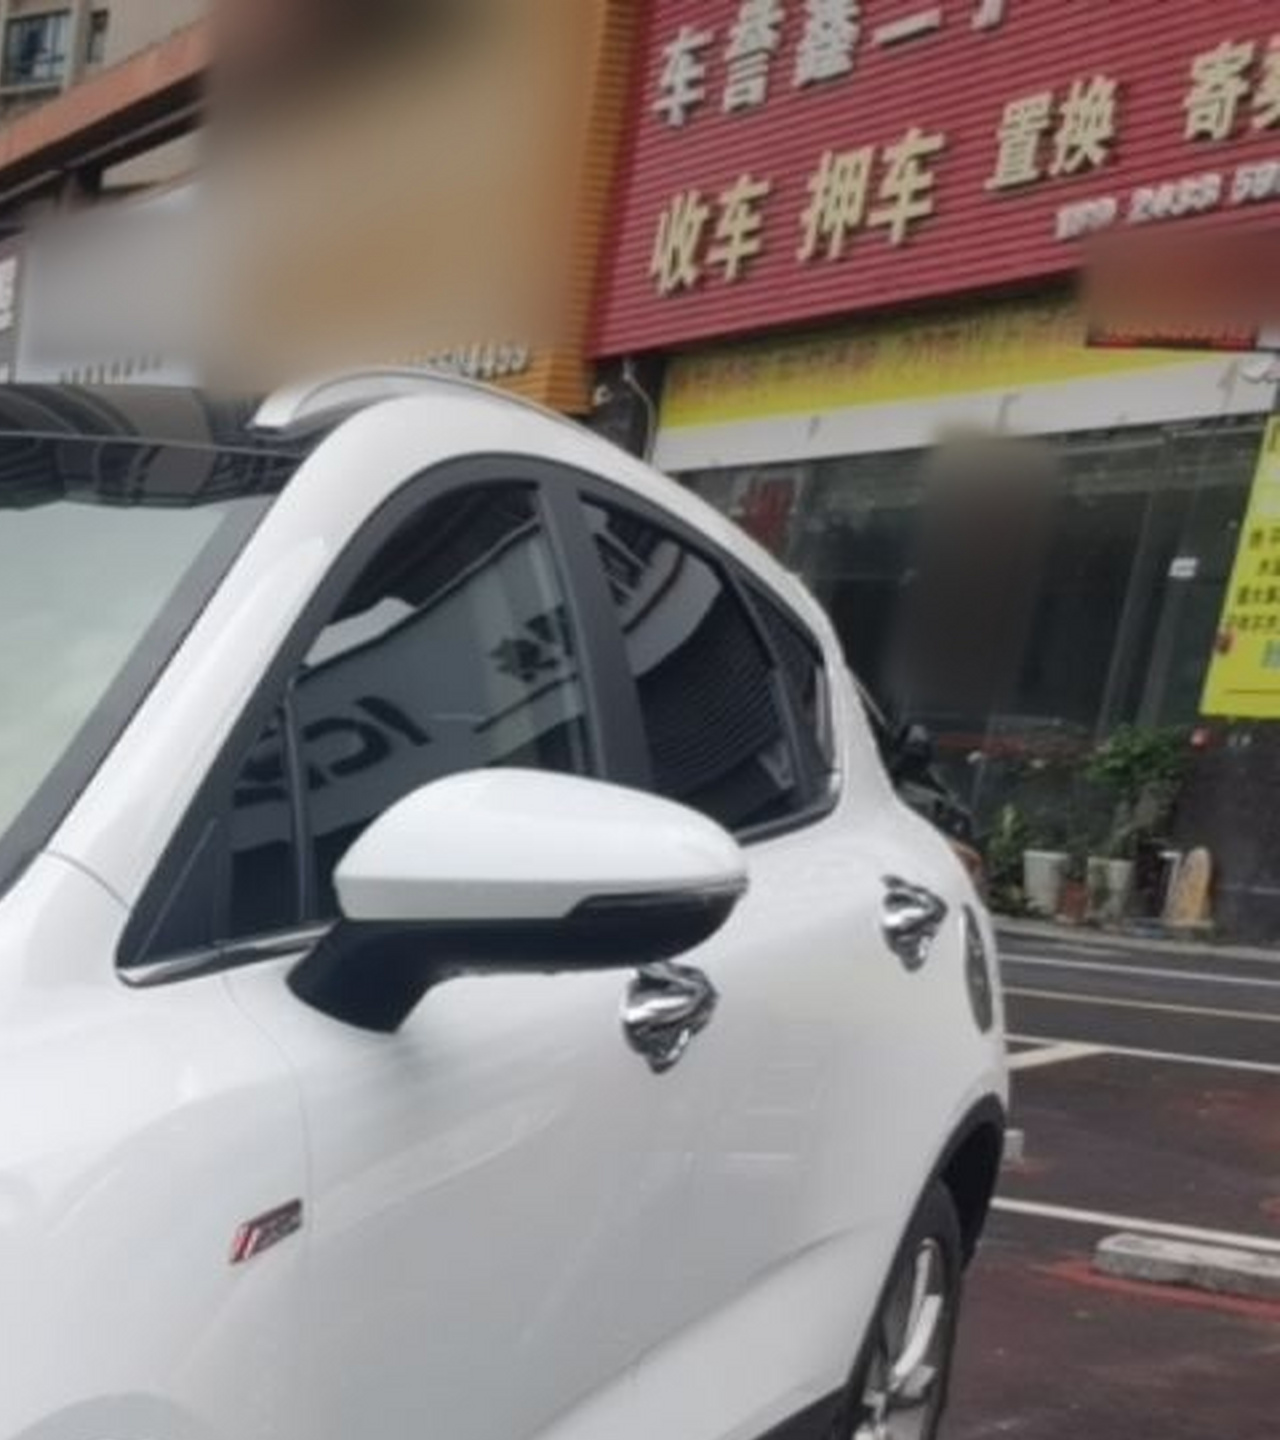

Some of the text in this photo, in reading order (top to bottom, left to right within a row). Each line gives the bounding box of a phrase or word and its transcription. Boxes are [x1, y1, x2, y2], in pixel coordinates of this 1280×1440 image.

[649, 173, 771, 297] 收车
[796, 127, 945, 262] 押车
[985, 74, 1119, 191] 置换
